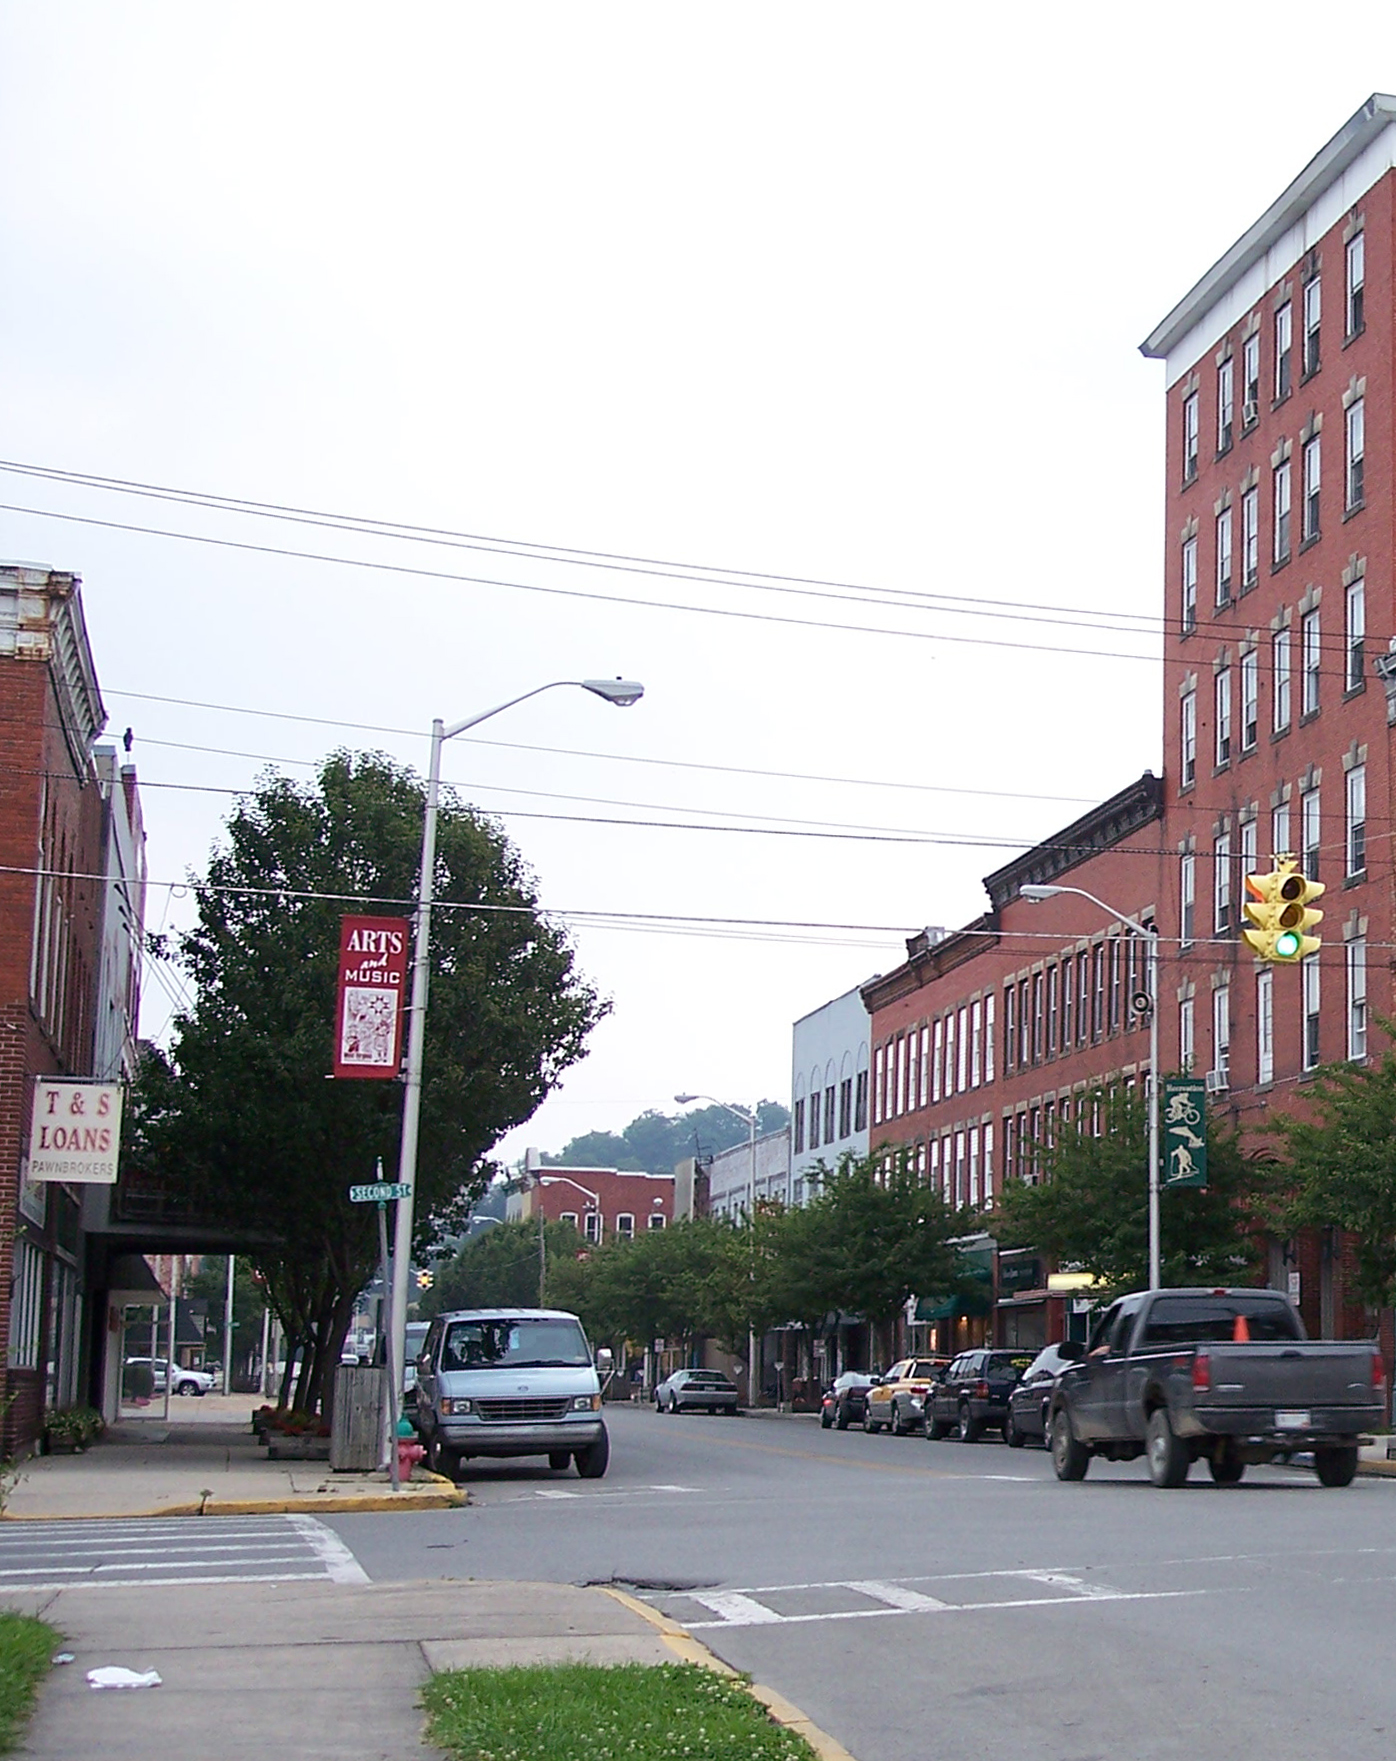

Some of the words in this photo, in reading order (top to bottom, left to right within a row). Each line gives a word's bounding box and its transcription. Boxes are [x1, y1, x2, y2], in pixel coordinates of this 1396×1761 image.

[347, 929, 403, 954] ARTS
[360, 952, 388, 969] and
[345, 969, 401, 984] MUSIC
[46, 1091, 59, 1114] T
[70, 1091, 85, 1115] &
[97, 1092, 111, 1117] S
[39, 1125, 111, 1152] LOANS
[31, 1160, 115, 1176] PAWNBROKERS
[355, 1185, 393, 1199] SECOND
[396, 1184, 408, 1198] ST
